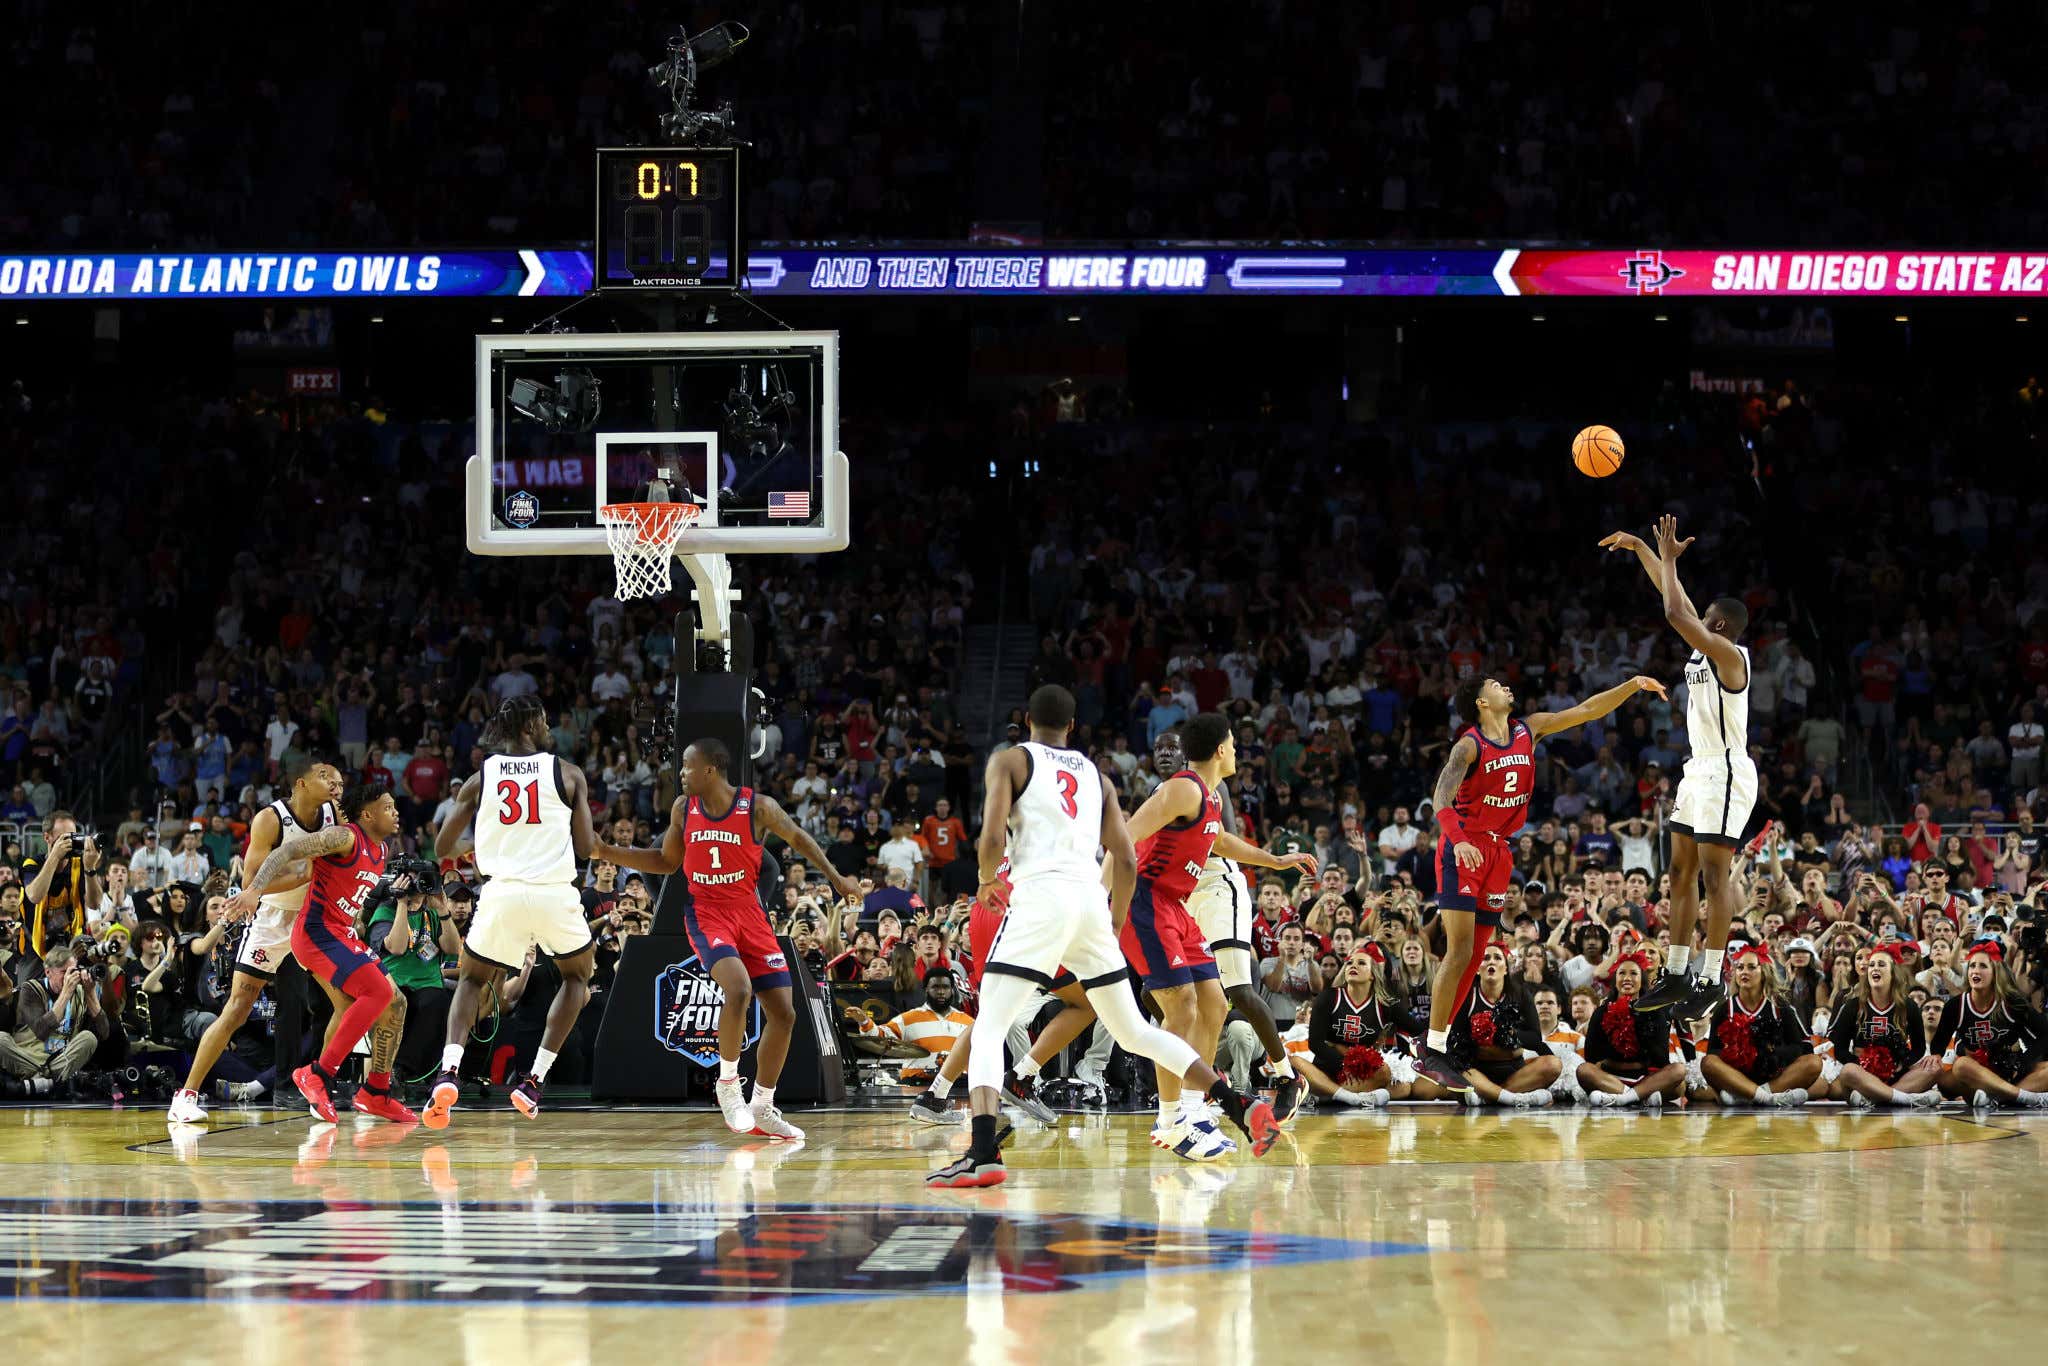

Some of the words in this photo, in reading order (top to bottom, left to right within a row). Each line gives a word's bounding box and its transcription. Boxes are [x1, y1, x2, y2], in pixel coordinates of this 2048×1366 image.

[131, 258, 317, 293] ATLANTIC
[333, 256, 440, 291] OWLS
[633, 278, 701, 286] DAKTRONICS
[810, 257, 871, 288] AND
[877, 257, 949, 288] THEN
[954, 257, 1043, 288] THERE
[1048, 257, 1127, 287] WERE
[1130, 257, 1206, 287] FOUR
[1711, 255, 1780, 290] SAN
[1787, 255, 1888, 291] DIEGO
[1896, 255, 1995, 291] STATE
[1999, 255, 2048, 291] AZ
[293, 373, 334, 388] HTX
[512, 499, 533, 509] FINAL
[513, 508, 535, 517] FOUR
[500, 761, 539, 775] MENSAH
[1485, 754, 1531, 774] FLORIDA
[1503, 771, 1518, 793] 2
[497, 779, 542, 825] 31
[1056, 769, 1078, 820] 3
[690, 829, 742, 846] FLORIDA
[936, 826, 949, 846] 5
[709, 846, 722, 869] 1
[692, 869, 745, 885] ATLANTIC
[351, 884, 372, 906] 15
[675, 980, 726, 1005] FINA
